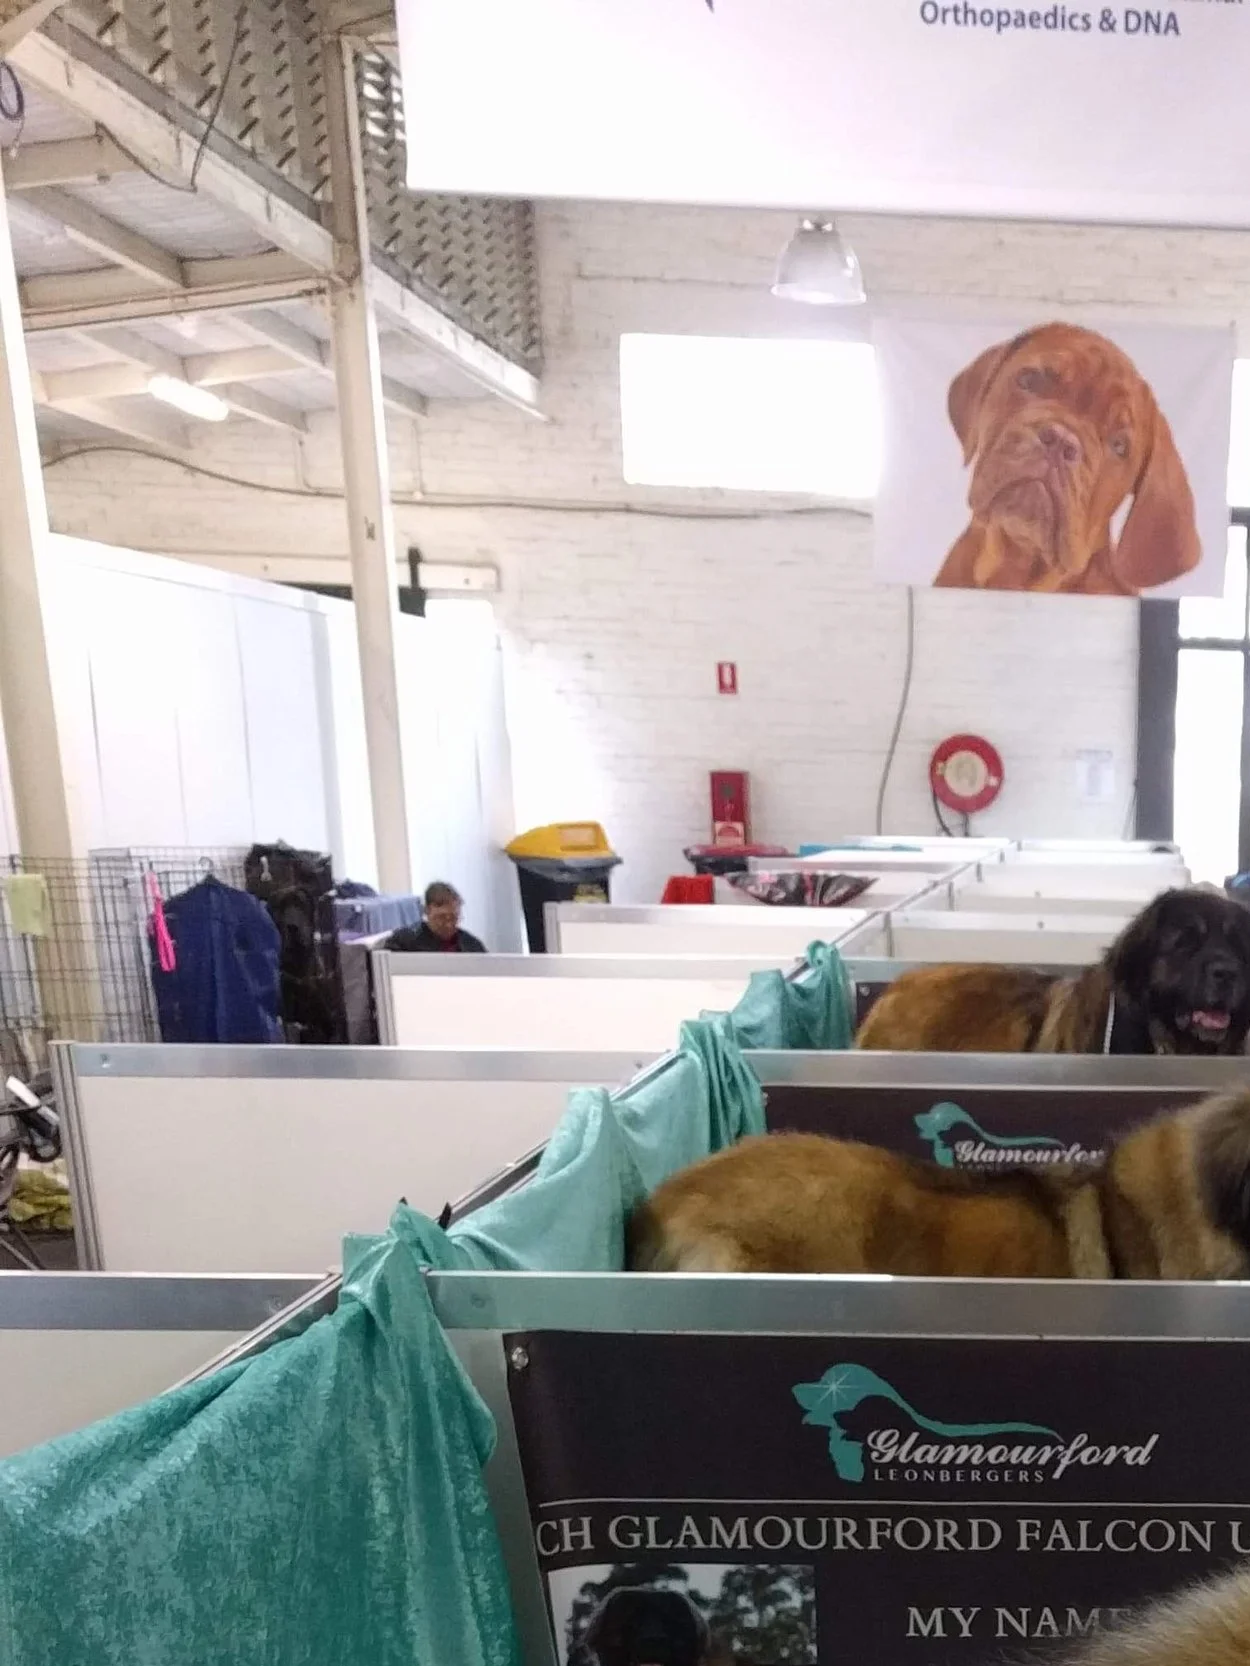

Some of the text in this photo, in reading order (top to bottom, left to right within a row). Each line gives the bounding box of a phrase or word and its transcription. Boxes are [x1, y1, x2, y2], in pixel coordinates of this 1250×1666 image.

[918, 1, 1181, 36] Orthopaedics & DNA
[866, 1428, 1160, 1480] Glamourford
[873, 1469, 1046, 1483] LEONBERGERS
[536, 1515, 596, 1557] CH
[608, 1515, 1000, 1551] GLAMOURFORD
[1016, 1518, 1216, 1553] FALCON
[906, 1606, 982, 1638] MY
